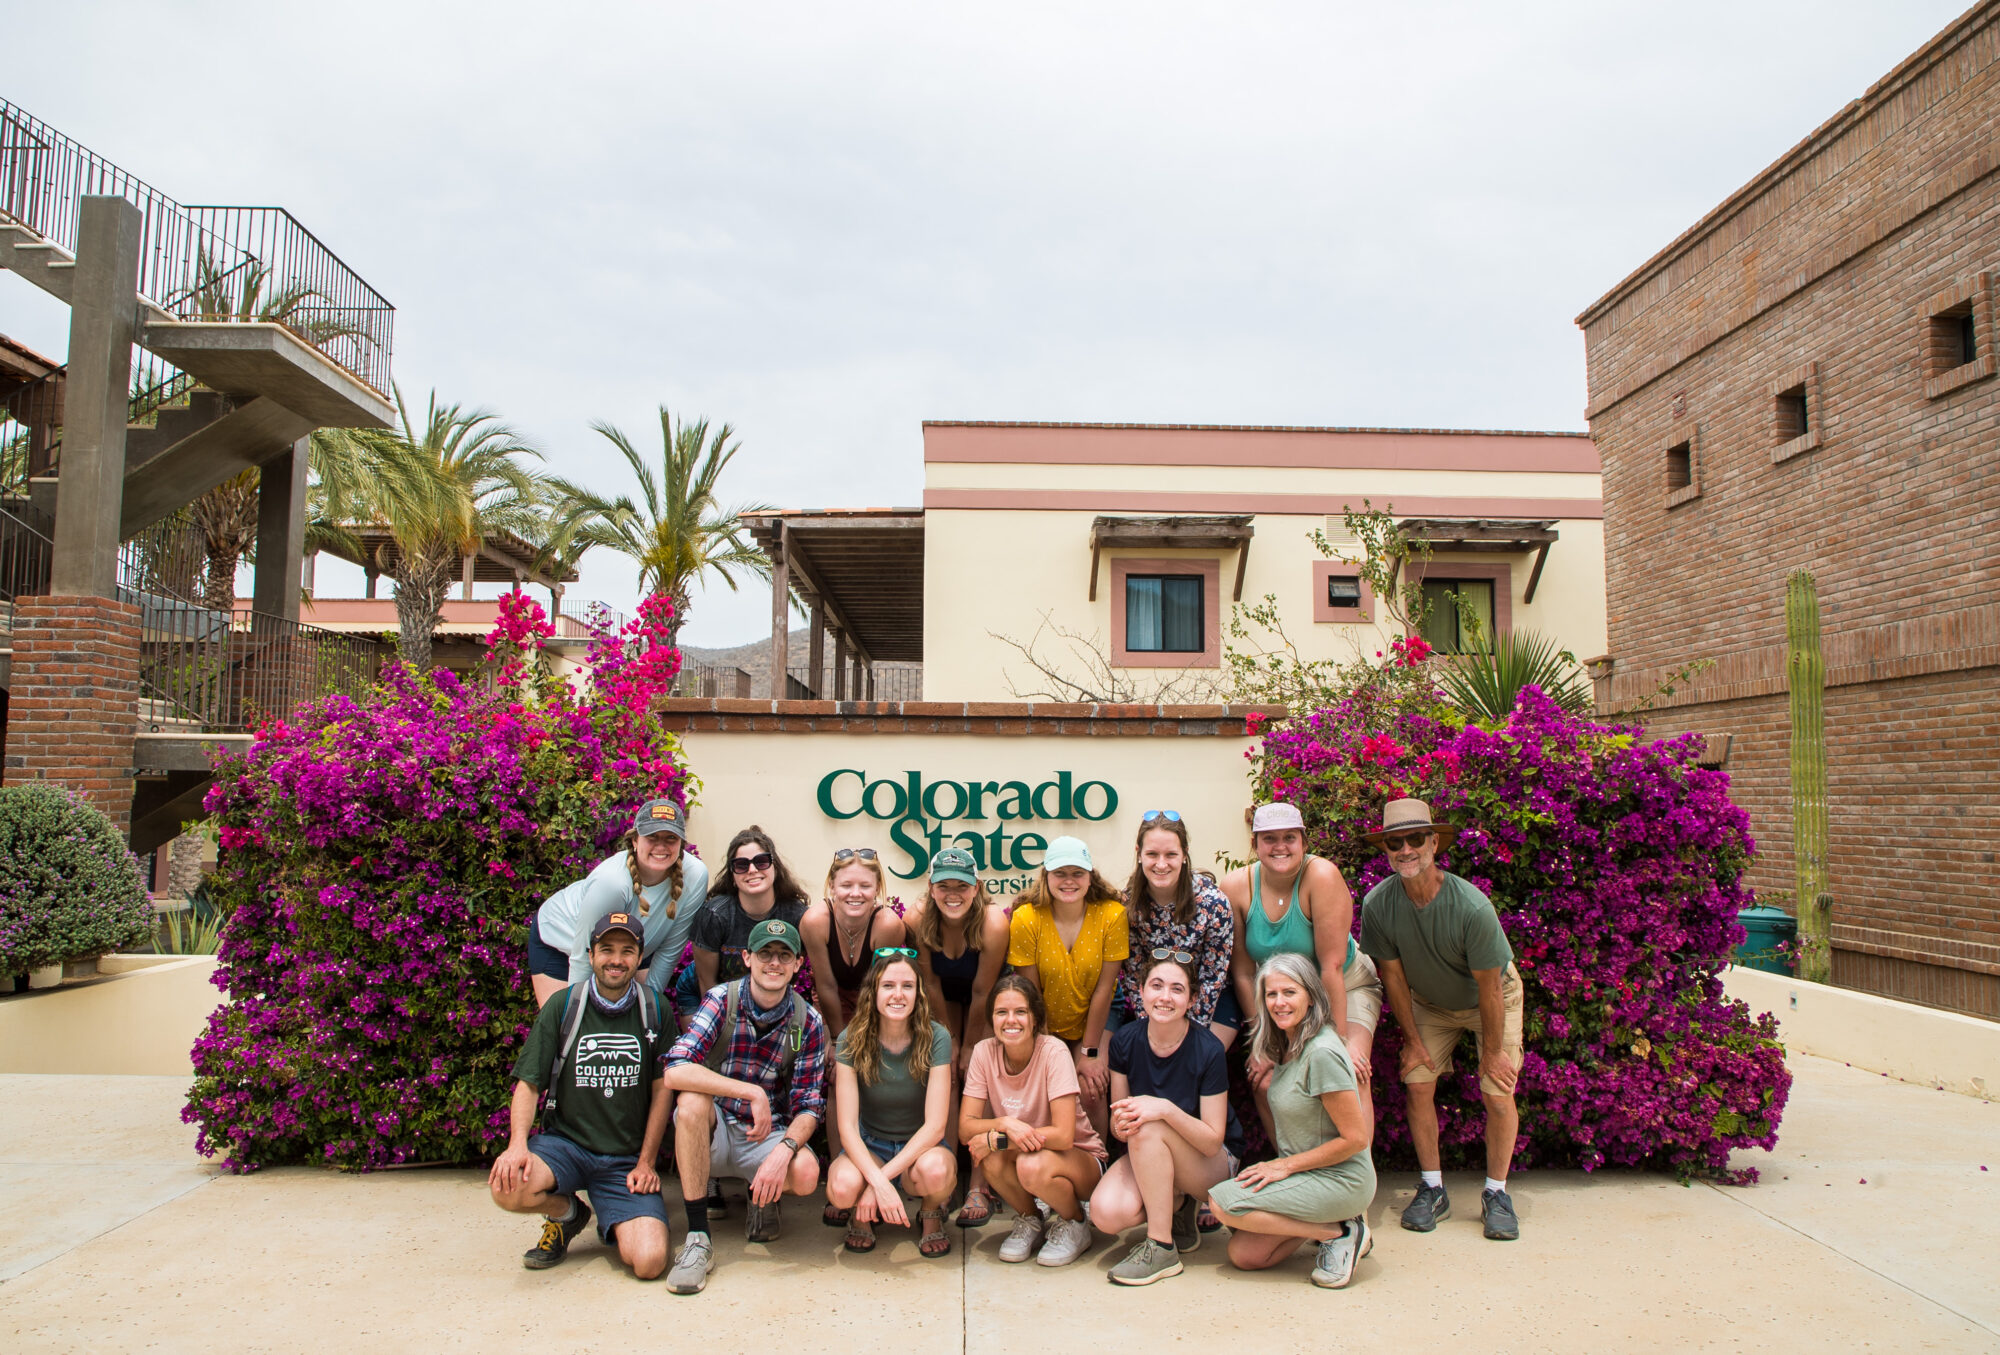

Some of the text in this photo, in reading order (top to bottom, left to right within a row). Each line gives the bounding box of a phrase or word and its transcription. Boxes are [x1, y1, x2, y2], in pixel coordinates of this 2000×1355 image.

[816, 769, 1119, 821] Colorado
[888, 817, 1048, 880] State
[576, 1065, 640, 1076] COLORADO
[590, 1076, 628, 1088] STATE
